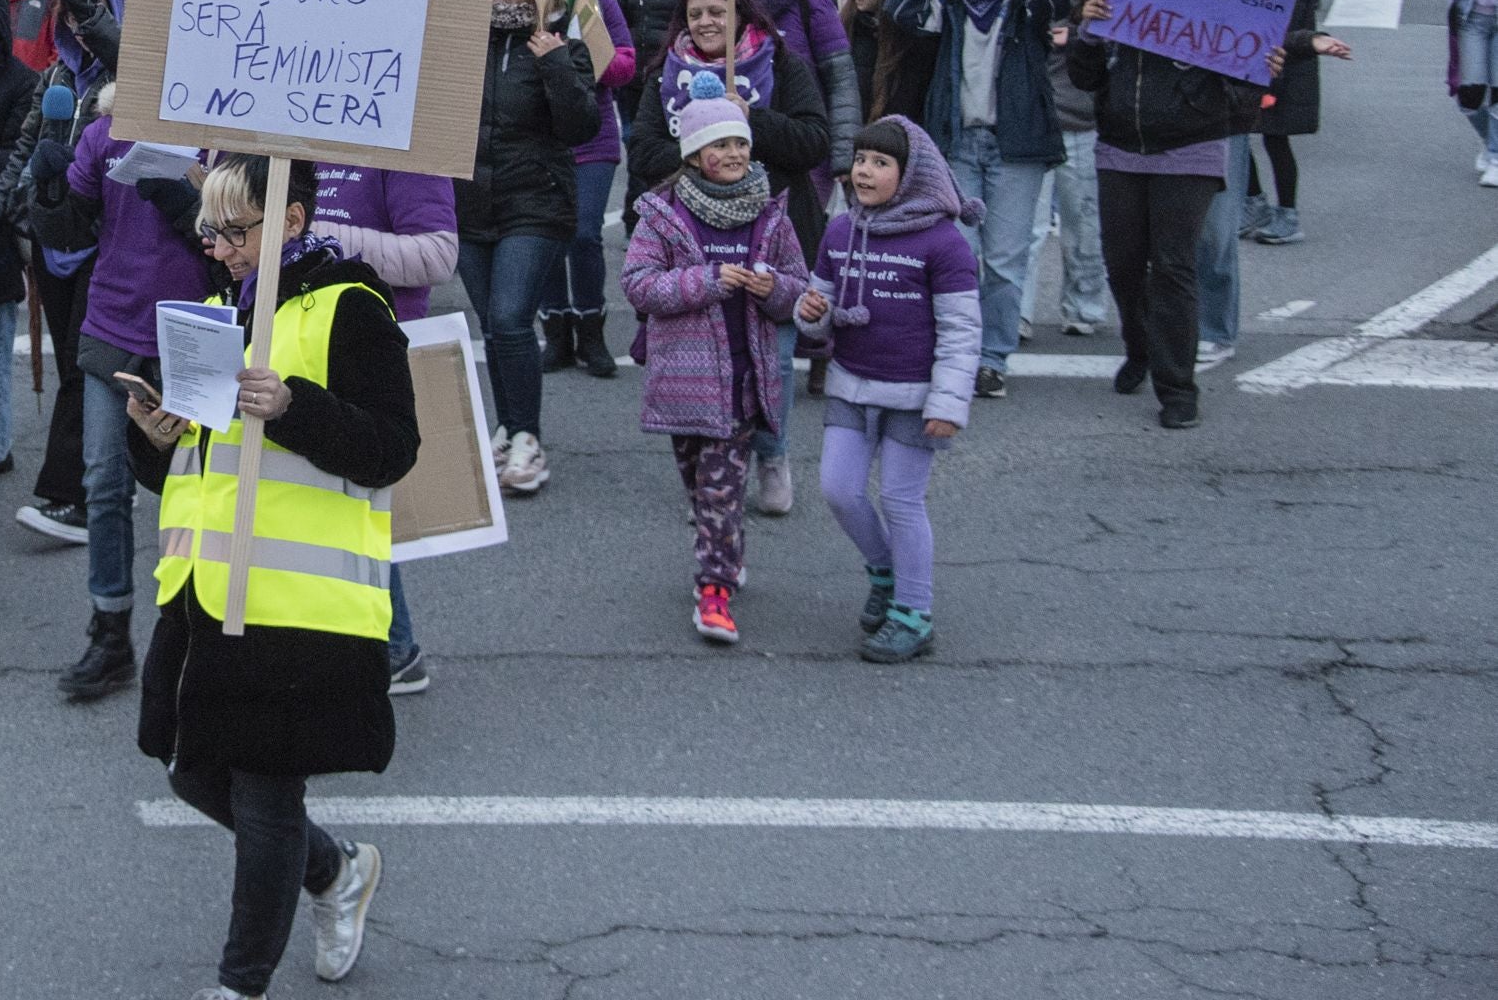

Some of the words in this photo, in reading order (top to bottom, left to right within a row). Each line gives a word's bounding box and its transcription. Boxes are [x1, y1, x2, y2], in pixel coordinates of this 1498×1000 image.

[178, 1, 270, 45] SERÁ
[1111, 2, 1262, 60] MATANDO
[232, 41, 404, 93] FEMINISTA
[168, 82, 188, 111] O
[205, 87, 256, 117] NO
[287, 91, 382, 129] SERÁ
[873, 288, 891, 298] Con
